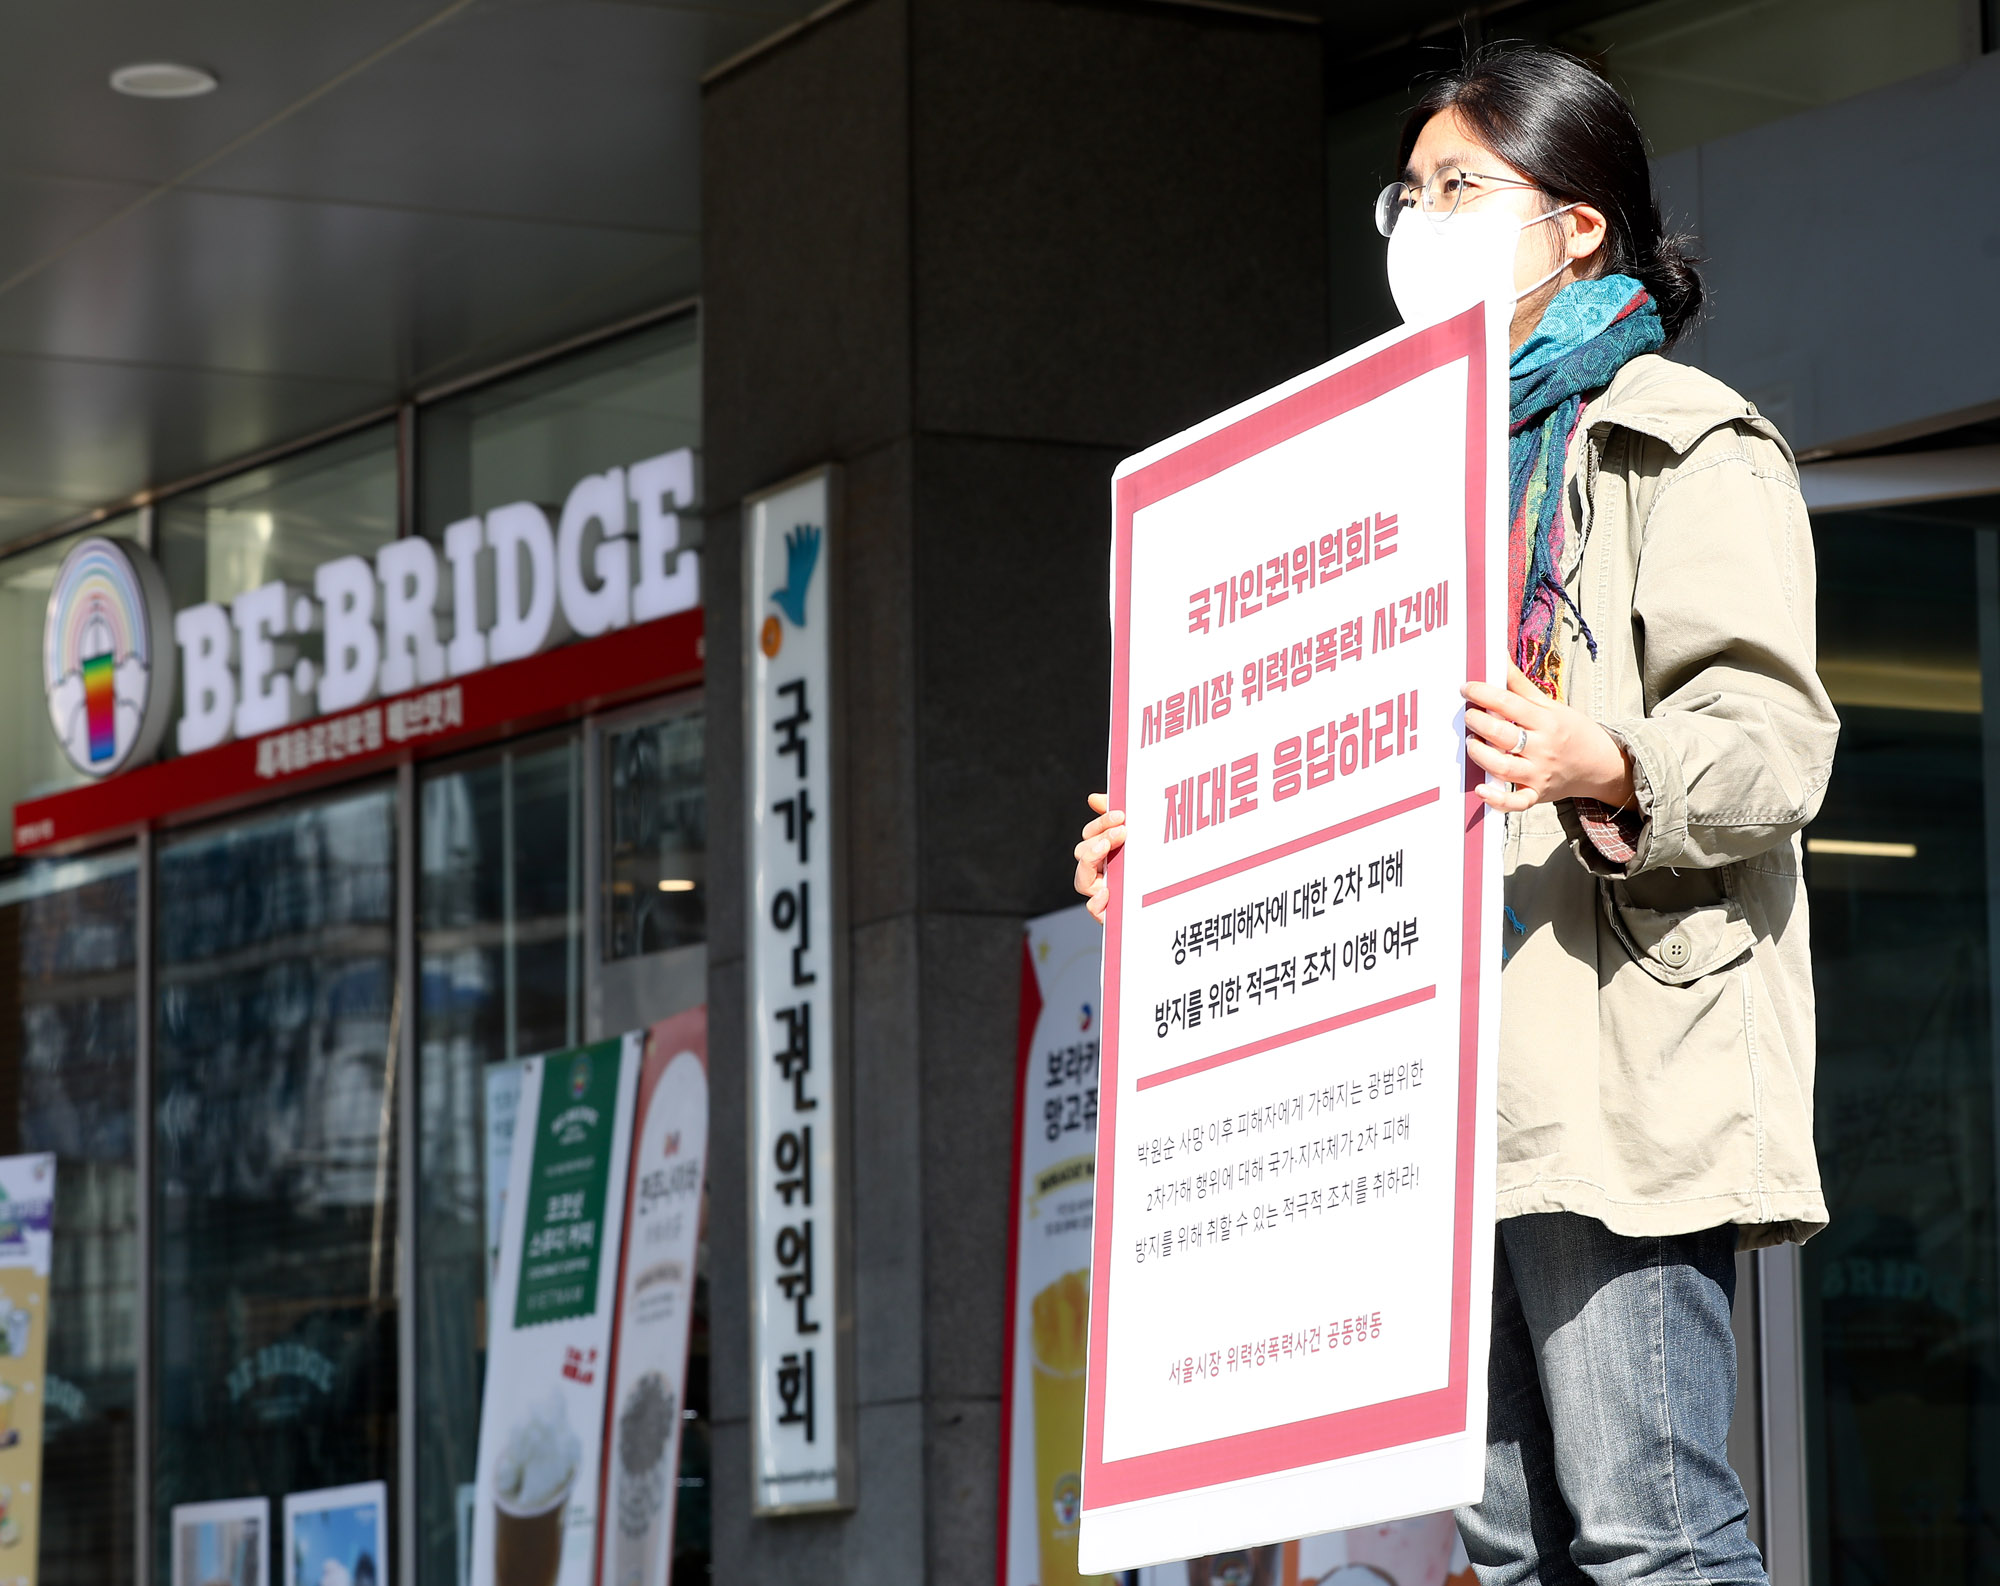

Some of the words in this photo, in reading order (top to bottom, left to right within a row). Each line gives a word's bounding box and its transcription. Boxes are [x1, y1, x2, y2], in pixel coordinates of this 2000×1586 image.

[175, 448, 700, 755] BE:BRIDGE
[1188, 512, 1398, 634] 국가인권위원회는
[1140, 671, 1233, 748] 서울시장
[1242, 616, 1362, 706] 위력성폭력
[1373, 580, 1448, 654] 사건에
[1164, 753, 1258, 843] 제대로
[1273, 690, 1418, 802] 응답하라!
[1171, 890, 1288, 965] 성폭력피해자에
[1293, 877, 1327, 920] 대한
[1333, 864, 1363, 906] 2차
[1368, 849, 1403, 894] 피해
[1155, 989, 1203, 1038] 방지를
[1208, 976, 1241, 1019] 위한
[1246, 956, 1296, 1005] 적극적
[1301, 942, 1336, 987] 조치
[1343, 929, 1377, 974] 이행
[1383, 917, 1419, 959] 여부
[773, 679, 820, 1444] 국가인권위원회
[1137, 1136, 1175, 1166] 박원순
[1179, 1125, 1204, 1153] 사망
[1209, 1114, 1233, 1143] 이후
[1237, 1093, 1304, 1134] 피해자에게
[1308, 1078, 1363, 1114] 가해지는
[1368, 1059, 1423, 1100] 광범위한
[1135, 1230, 1173, 1264] 방지를
[1177, 1222, 1203, 1252] 위해
[1206, 1214, 1232, 1244] 취할
[1236, 1210, 1249, 1236] 수
[1253, 1203, 1278, 1232] 있는
[1282, 1188, 1323, 1221] 적극적
[1327, 1176, 1367, 1209] 조치를
[1373, 1162, 1420, 1199] 취하라!
[1147, 1177, 1191, 1211] 2차가해
[1196, 1165, 1234, 1203] 행위에
[1238, 1152, 1264, 1186] 대해
[1357, 1122, 1379, 1152] 2차
[1383, 1113, 1411, 1145] 피해
[1168, 1349, 1221, 1385] 서울시장
[1226, 1325, 1321, 1373] 위력성폭력사건
[1327, 1311, 1383, 1349] 공동행동
